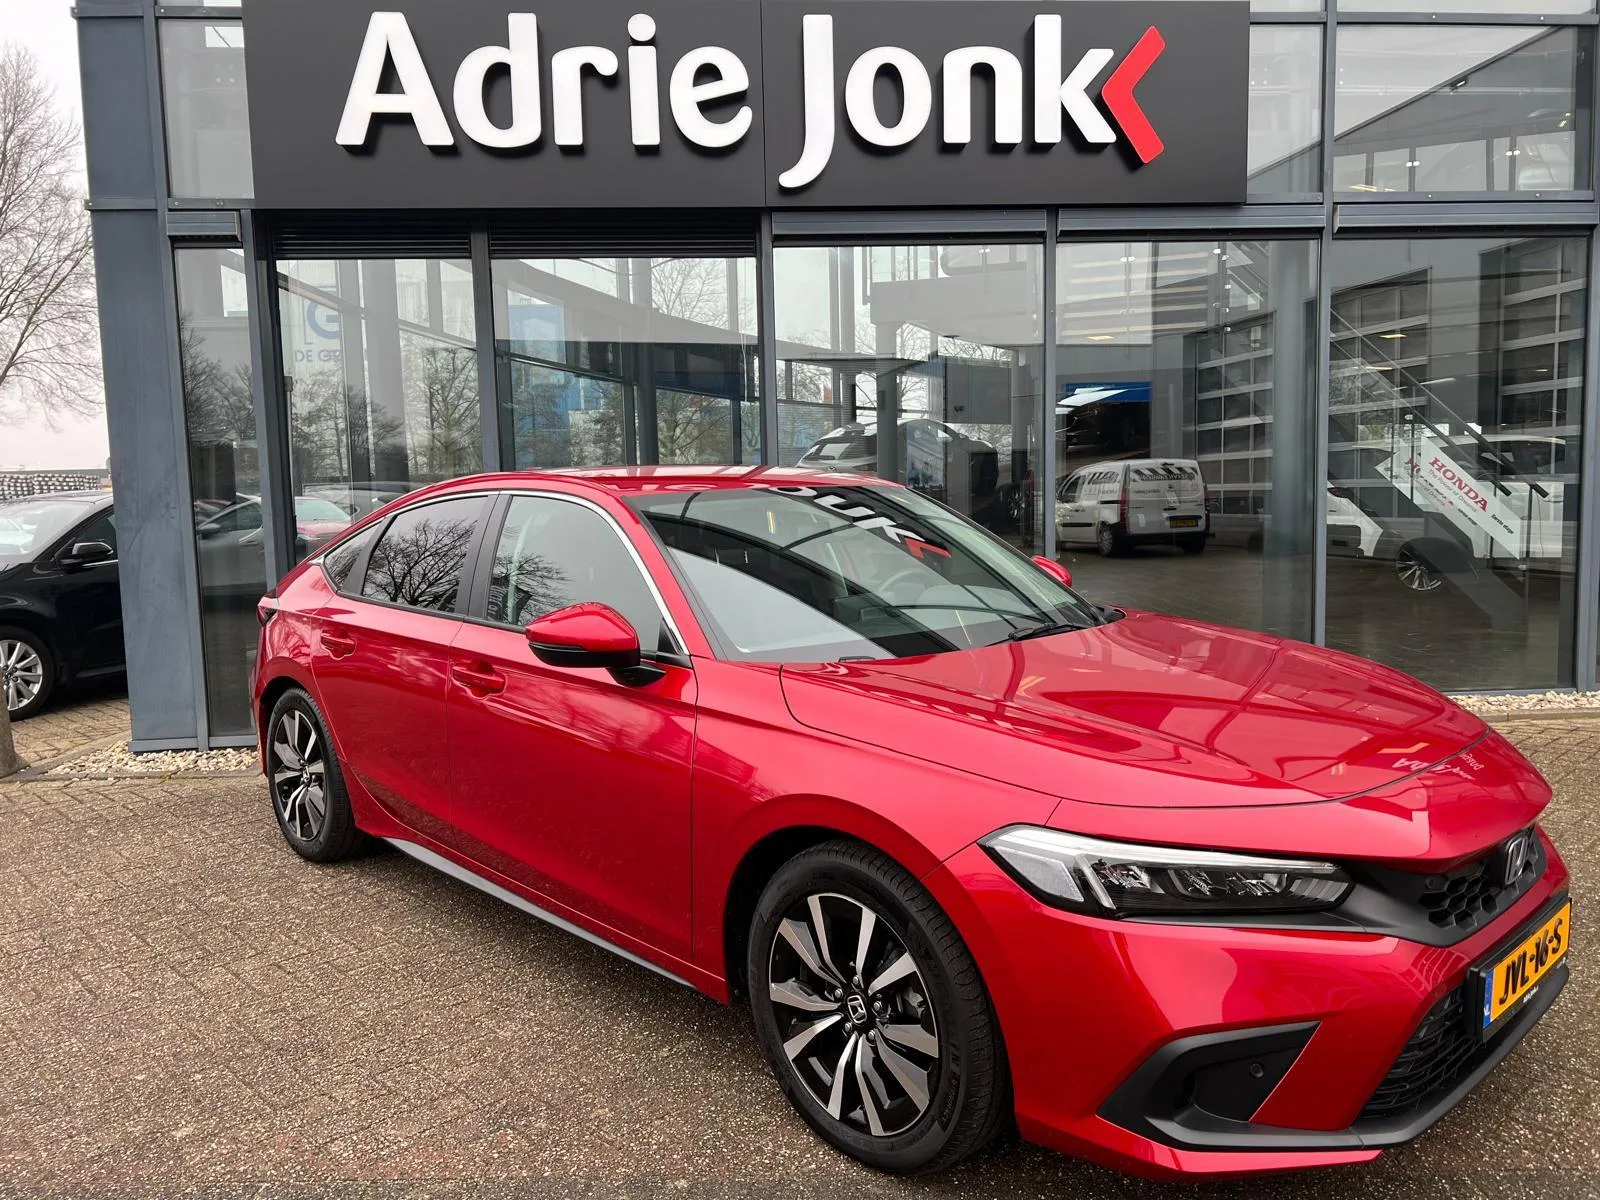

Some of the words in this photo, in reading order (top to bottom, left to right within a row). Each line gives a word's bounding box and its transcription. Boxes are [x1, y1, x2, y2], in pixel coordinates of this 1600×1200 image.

[334, 11, 753, 148] Adrie
[777, 14, 1117, 189] Jonk
[1429, 456, 1489, 513] HONDA
[1498, 917, 1563, 1006] JVL-16-S
